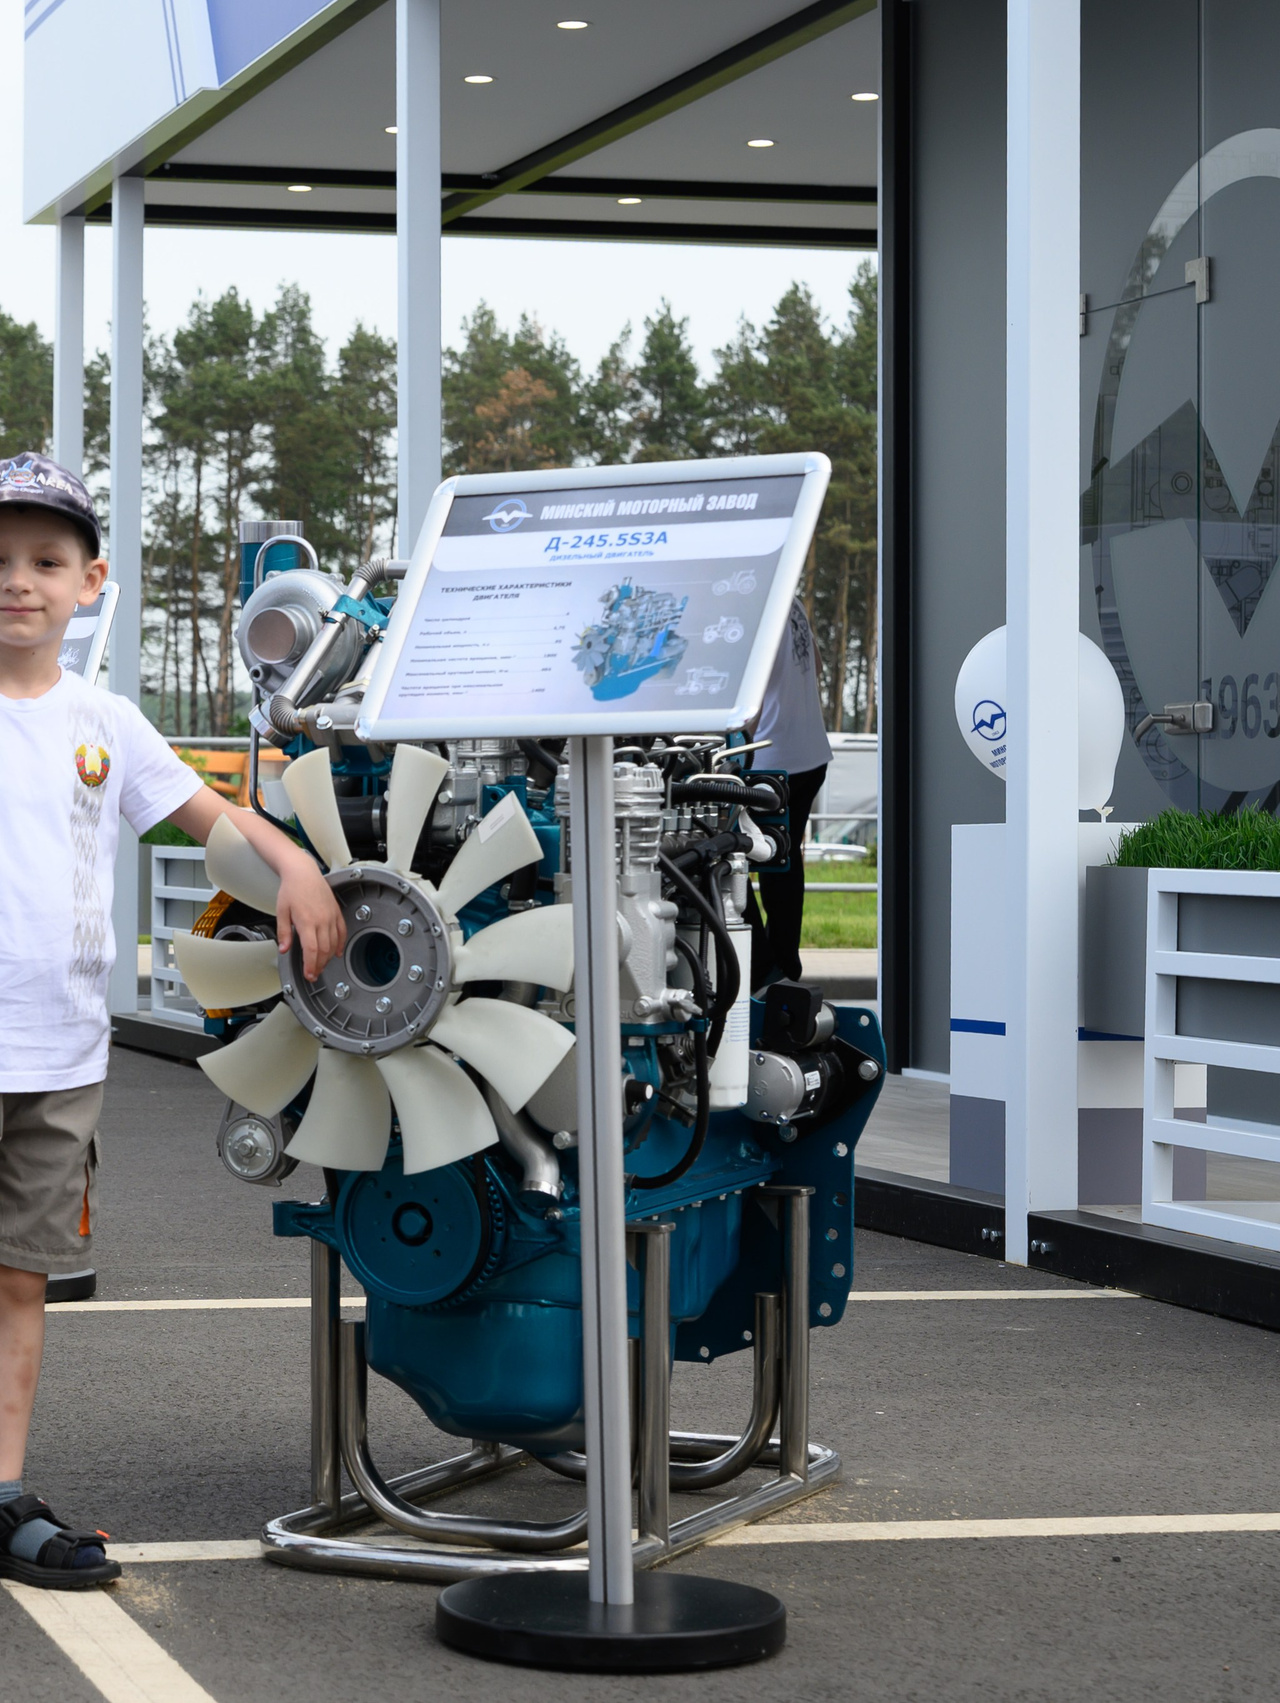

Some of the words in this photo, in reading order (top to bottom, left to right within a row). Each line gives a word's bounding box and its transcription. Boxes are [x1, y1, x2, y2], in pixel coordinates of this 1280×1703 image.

[539, 499, 615, 521] МИНСКИЙ
[616, 494, 706, 516] МОТОРНЫЙ
[705, 493, 760, 511] ЗАВОД
[543, 531, 669, 553] Д-245.5S3A
[549, 551, 603, 562] ДИЗЕЛЬНЫЙ
[604, 550, 655, 560] ДВИГАТЕЛЬ
[440, 584, 497, 594] ТЕХНИЧЕСКИЕ
[498, 581, 573, 591] ХАРАКТЕРИСТИКИ
[472, 592, 521, 602] ДВИГАТЕЛЯ
